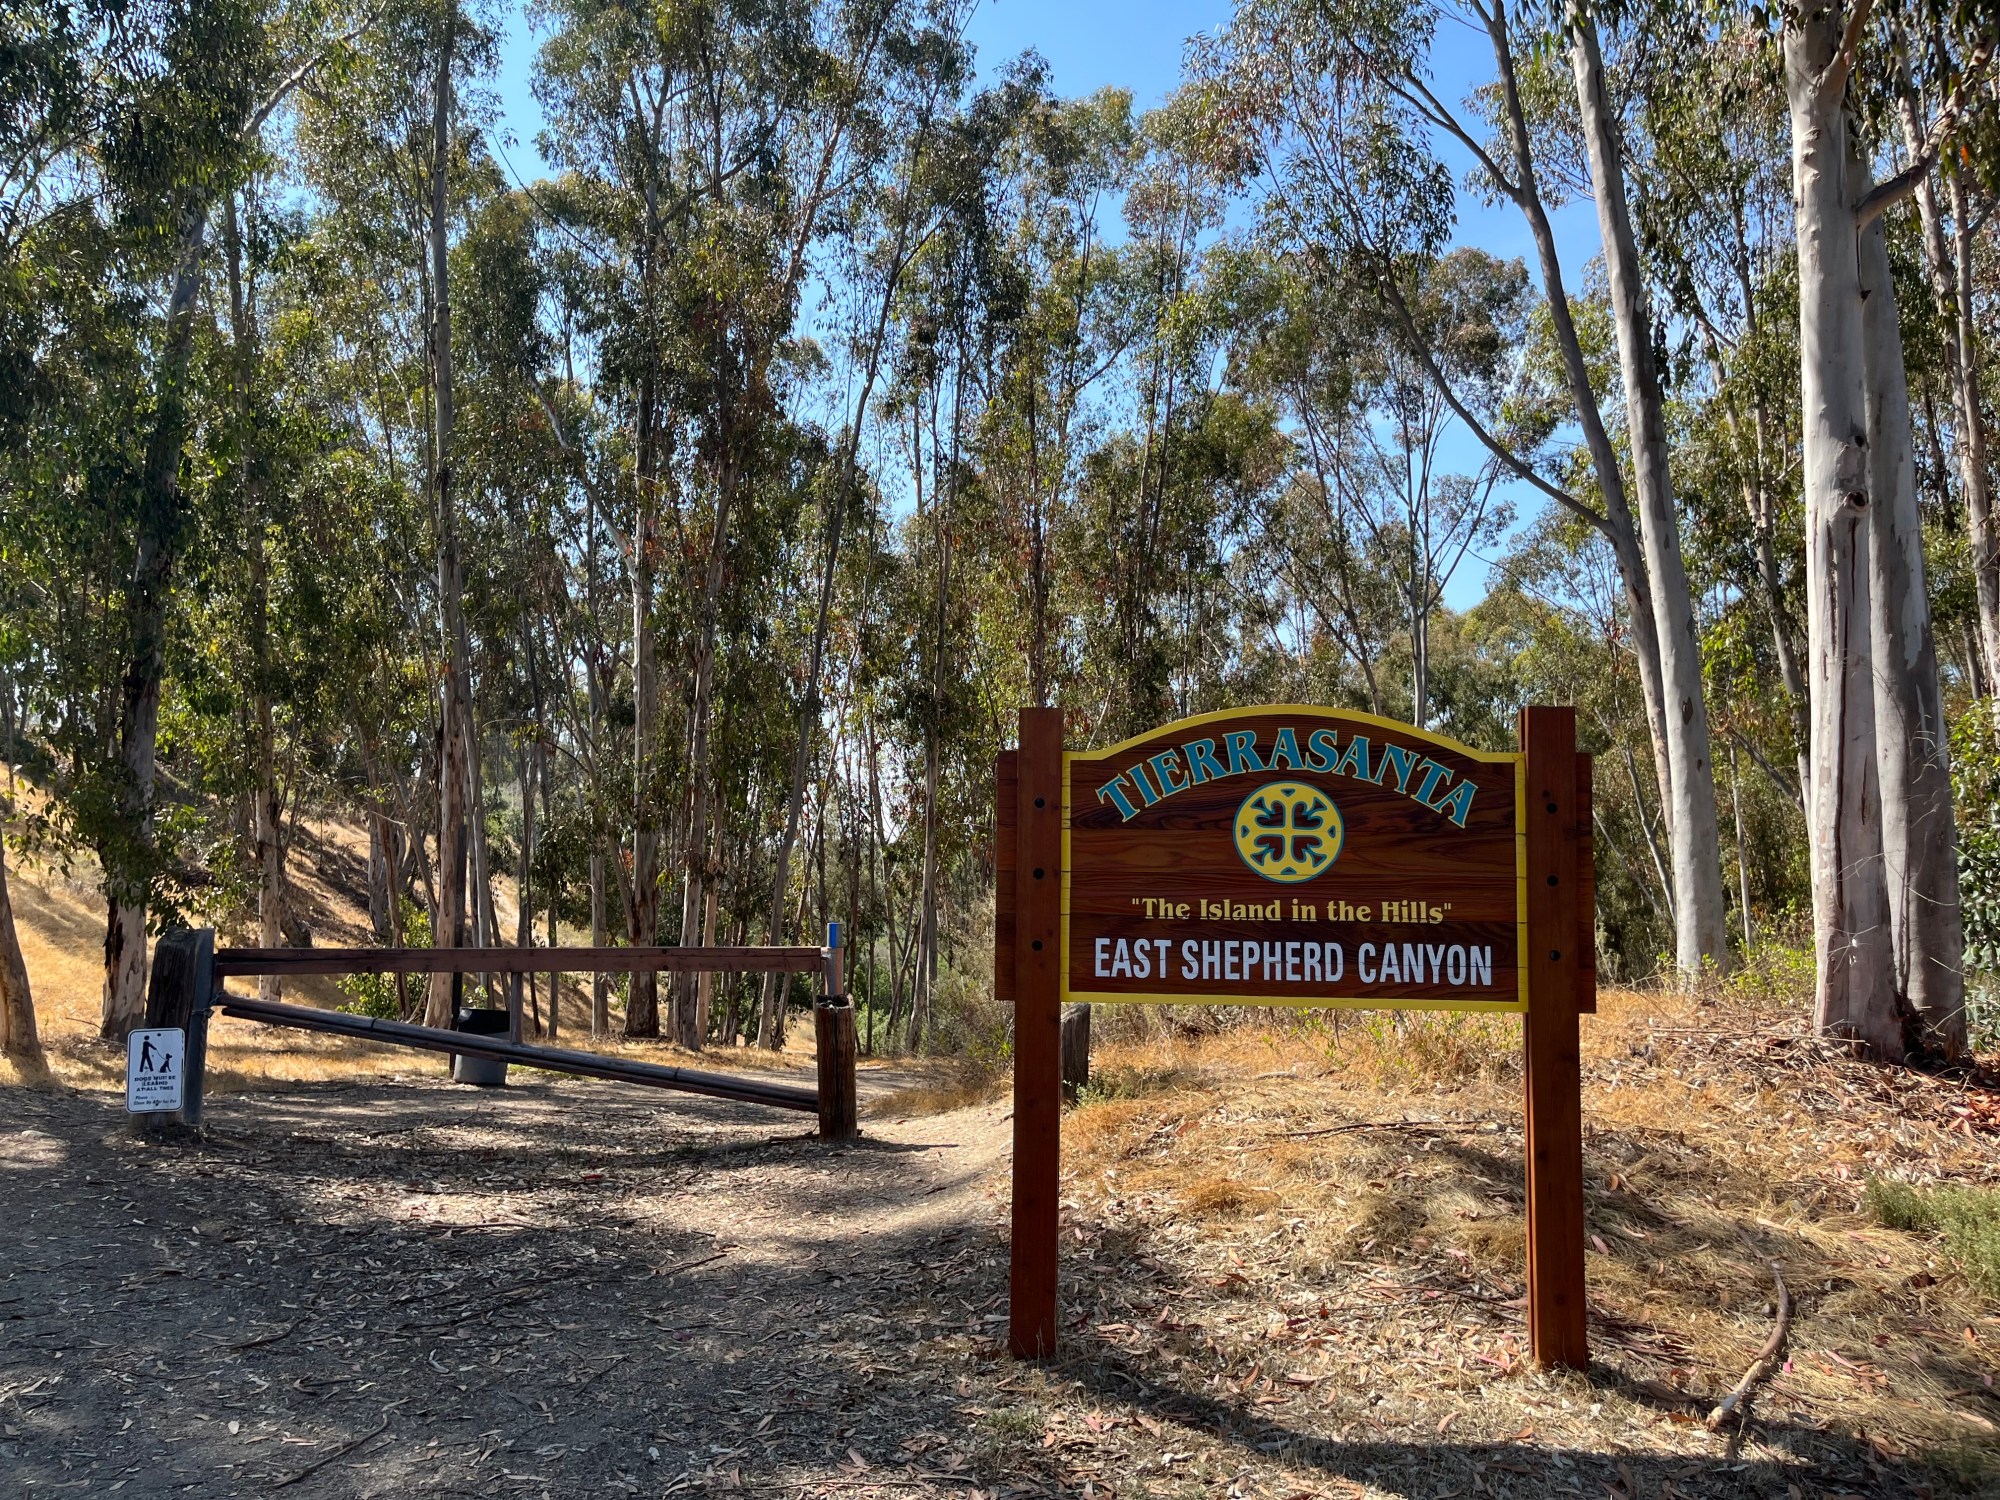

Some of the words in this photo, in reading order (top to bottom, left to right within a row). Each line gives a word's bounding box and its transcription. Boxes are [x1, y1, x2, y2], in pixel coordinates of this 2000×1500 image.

[1095, 728, 1479, 829] TIERRASANTA
[1132, 898, 1190, 921] "The
[1200, 898, 1282, 922] Island
[1291, 898, 1318, 922] in
[1327, 900, 1371, 923] the
[1381, 900, 1452, 925] Hills"
[1095, 937, 1172, 979] EAST
[1181, 939, 1344, 983] SHEPHERD
[1358, 942, 1492, 986] CANYON
